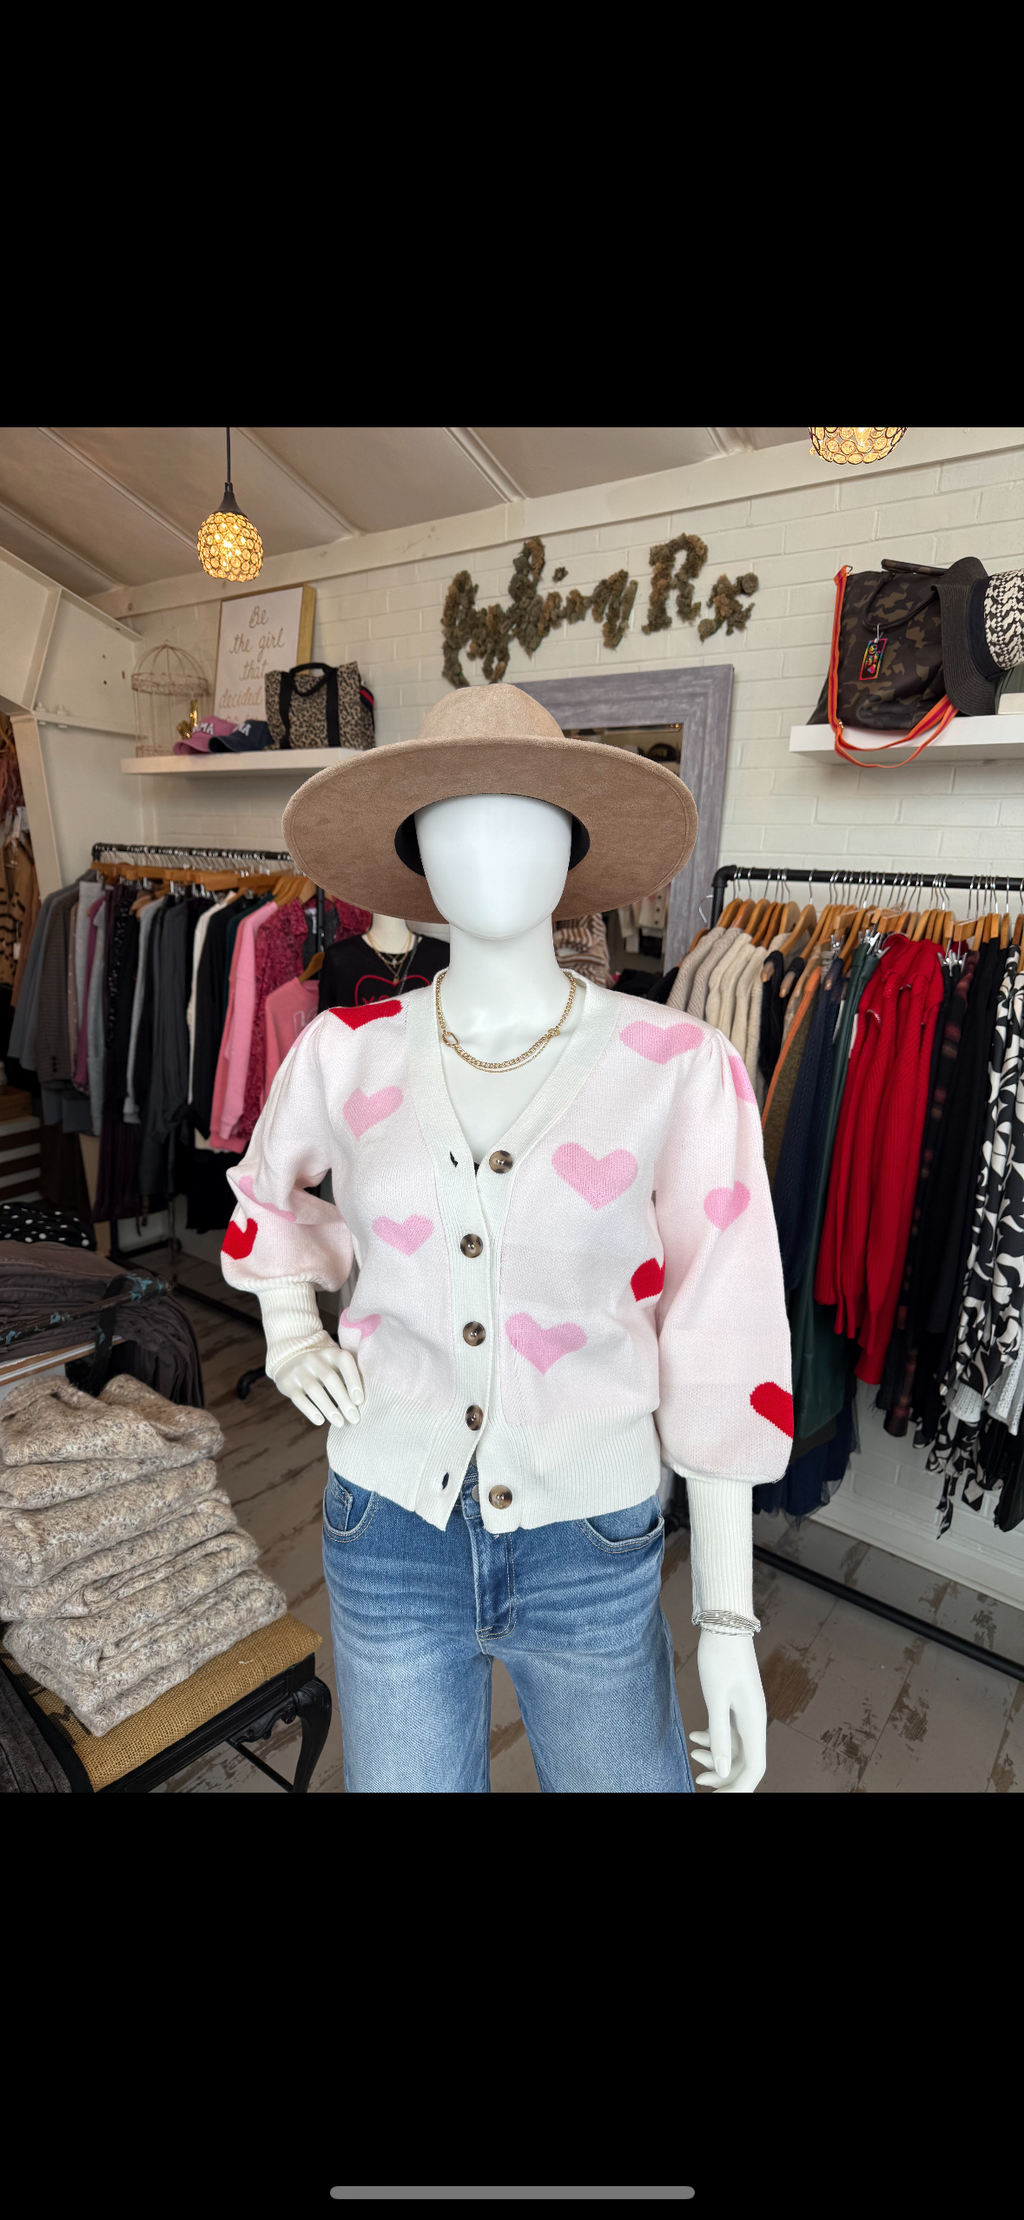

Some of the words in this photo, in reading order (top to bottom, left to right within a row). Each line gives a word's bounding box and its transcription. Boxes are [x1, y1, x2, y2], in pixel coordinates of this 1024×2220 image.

[248, 605, 270, 629] Be
[228, 633, 253, 654] the
[258, 627, 286, 662] girl
[238, 659, 268, 681] that
[219, 686, 263, 709] decided
